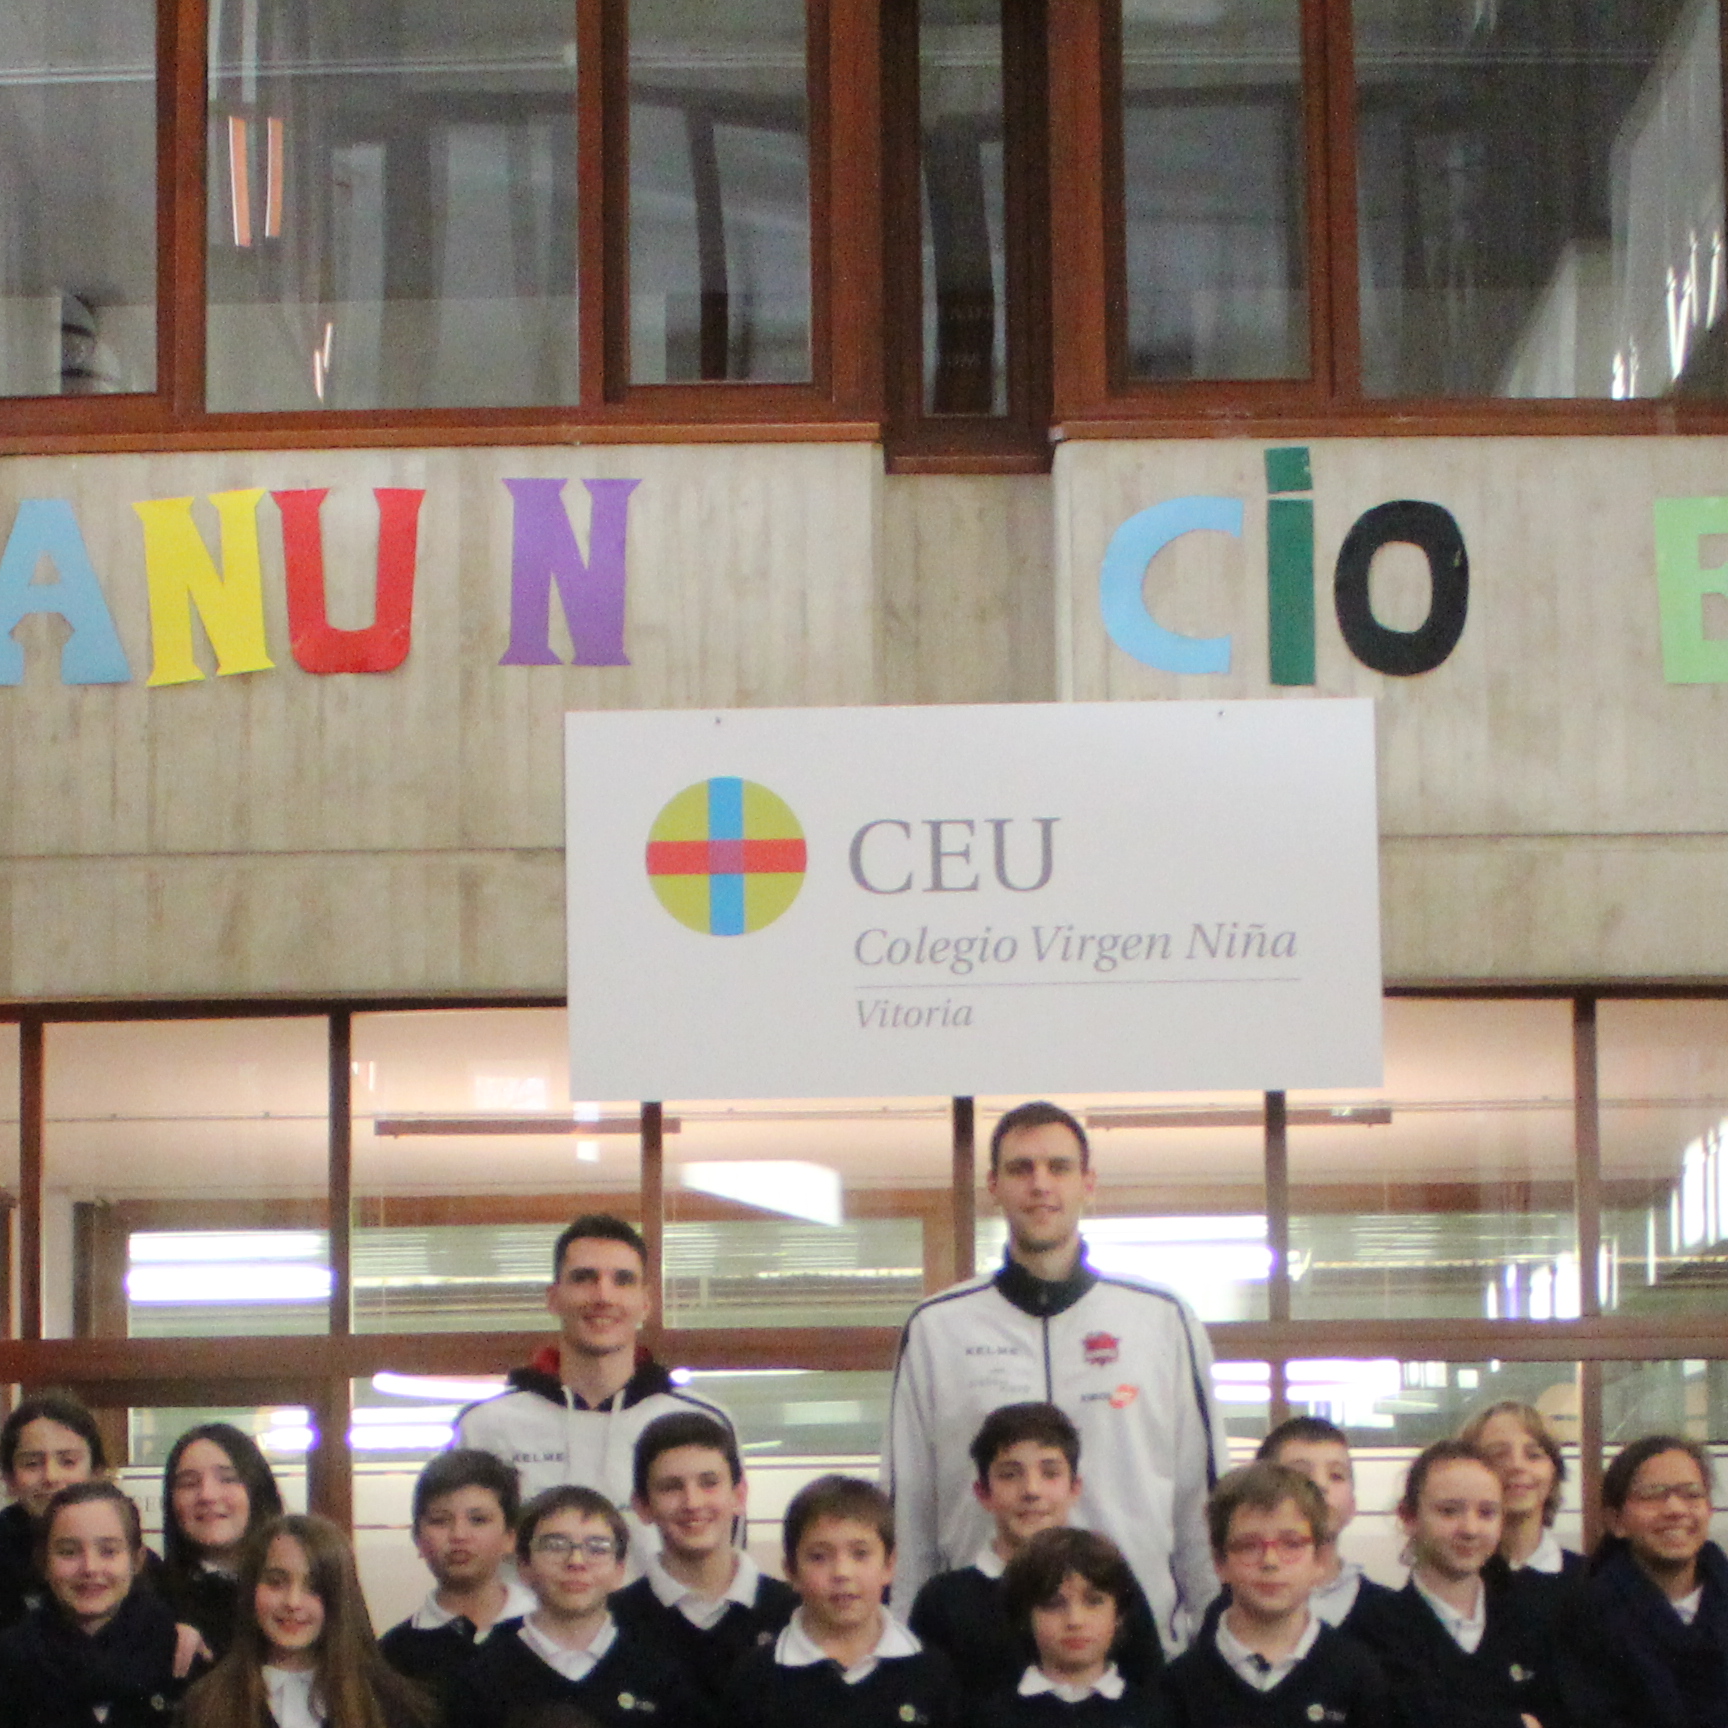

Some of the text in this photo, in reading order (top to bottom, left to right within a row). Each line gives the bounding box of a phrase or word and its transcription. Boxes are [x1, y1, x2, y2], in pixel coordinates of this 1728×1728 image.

[848, 817, 1061, 896] CEU
[854, 922, 1299, 976] Colegio Virgen Niña
[856, 999, 974, 1029] Vitoria
